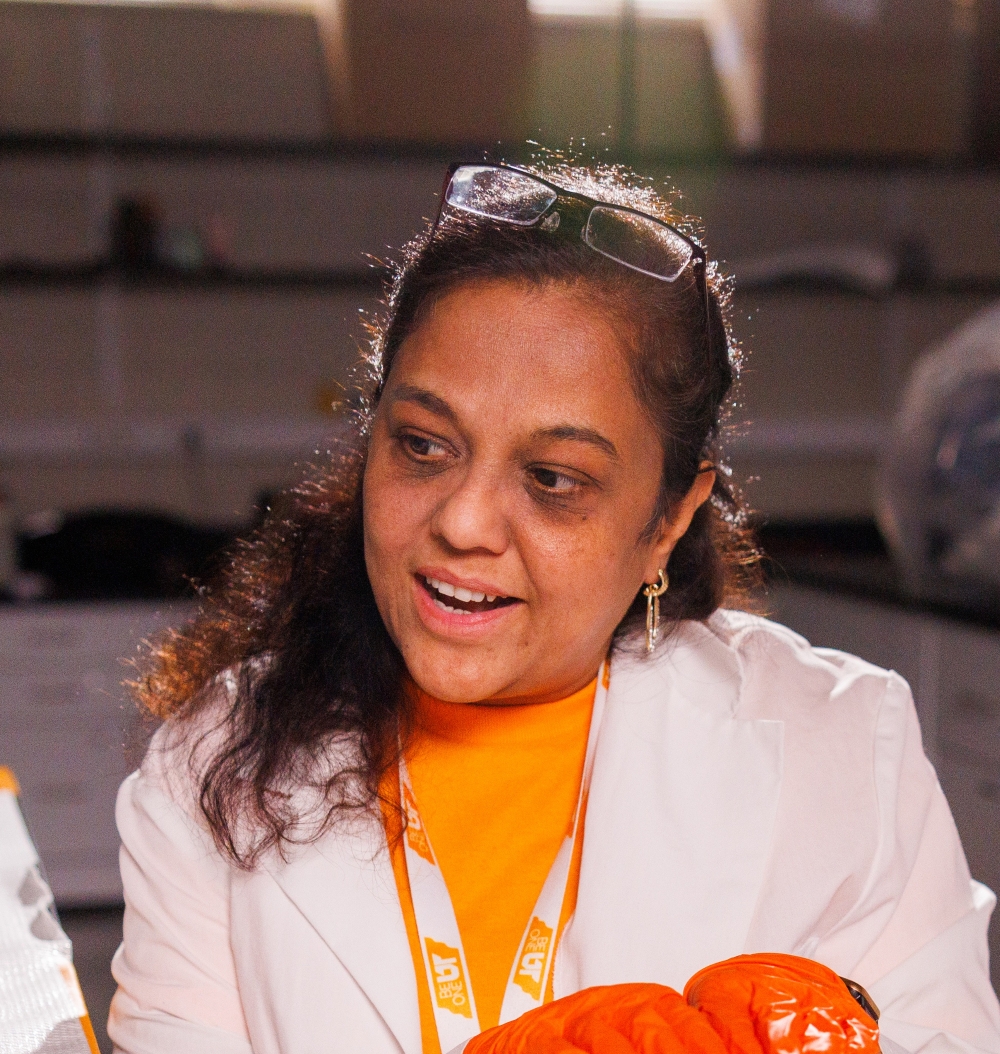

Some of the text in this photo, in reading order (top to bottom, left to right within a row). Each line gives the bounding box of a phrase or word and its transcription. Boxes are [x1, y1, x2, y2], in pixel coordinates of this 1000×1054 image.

[431, 952, 461, 983] UT
[438, 979, 453, 1000] BE
[450, 979, 466, 1007] ONE
